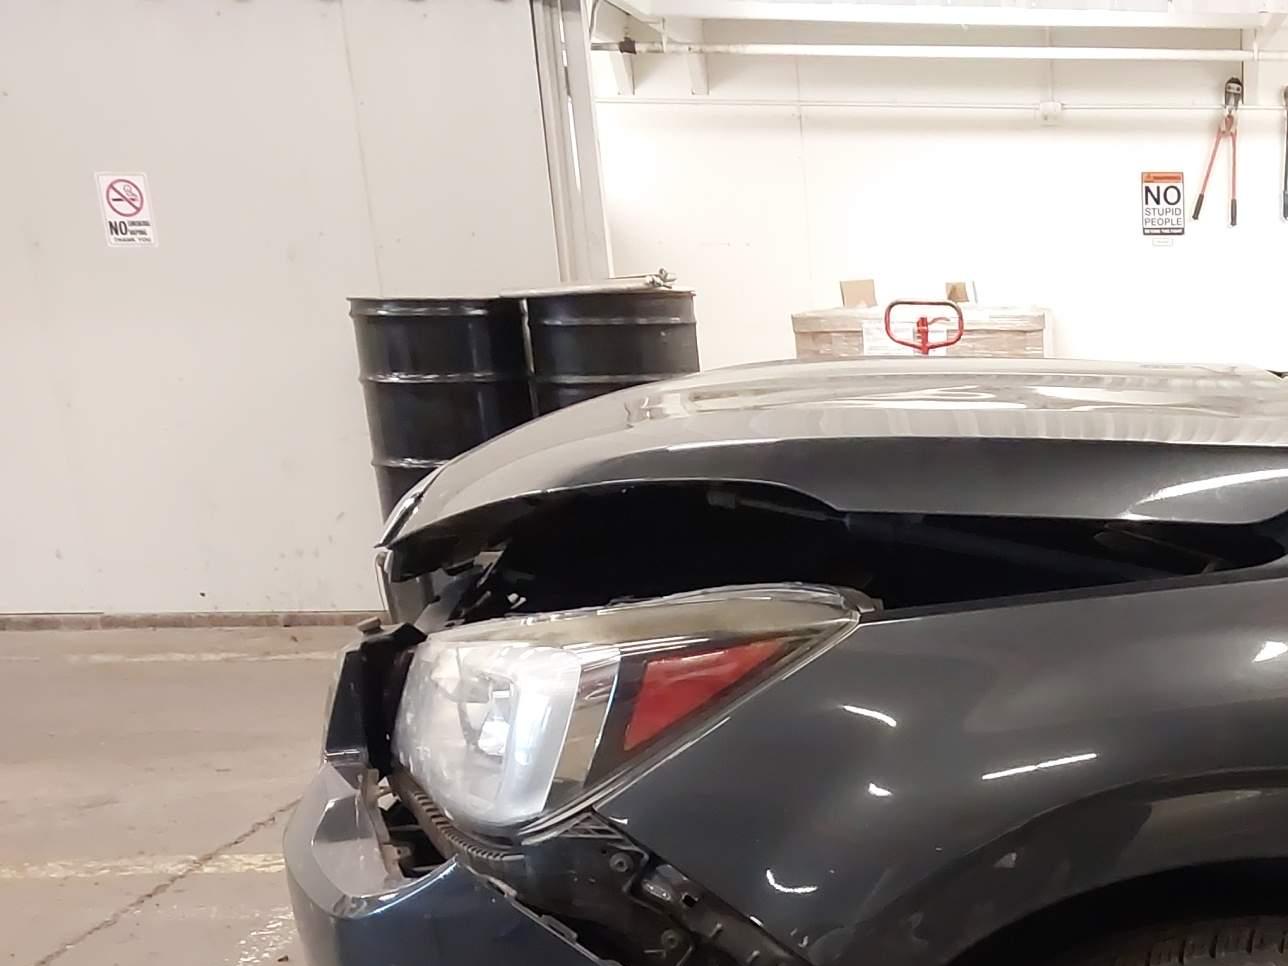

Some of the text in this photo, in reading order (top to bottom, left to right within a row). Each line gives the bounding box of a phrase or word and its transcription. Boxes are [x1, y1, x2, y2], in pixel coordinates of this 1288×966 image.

[1144, 185, 1181, 205] NO
[1145, 207, 1182, 217] STUPID
[108, 220, 128, 236] NO
[1144, 217, 1183, 226] PEOPLE
